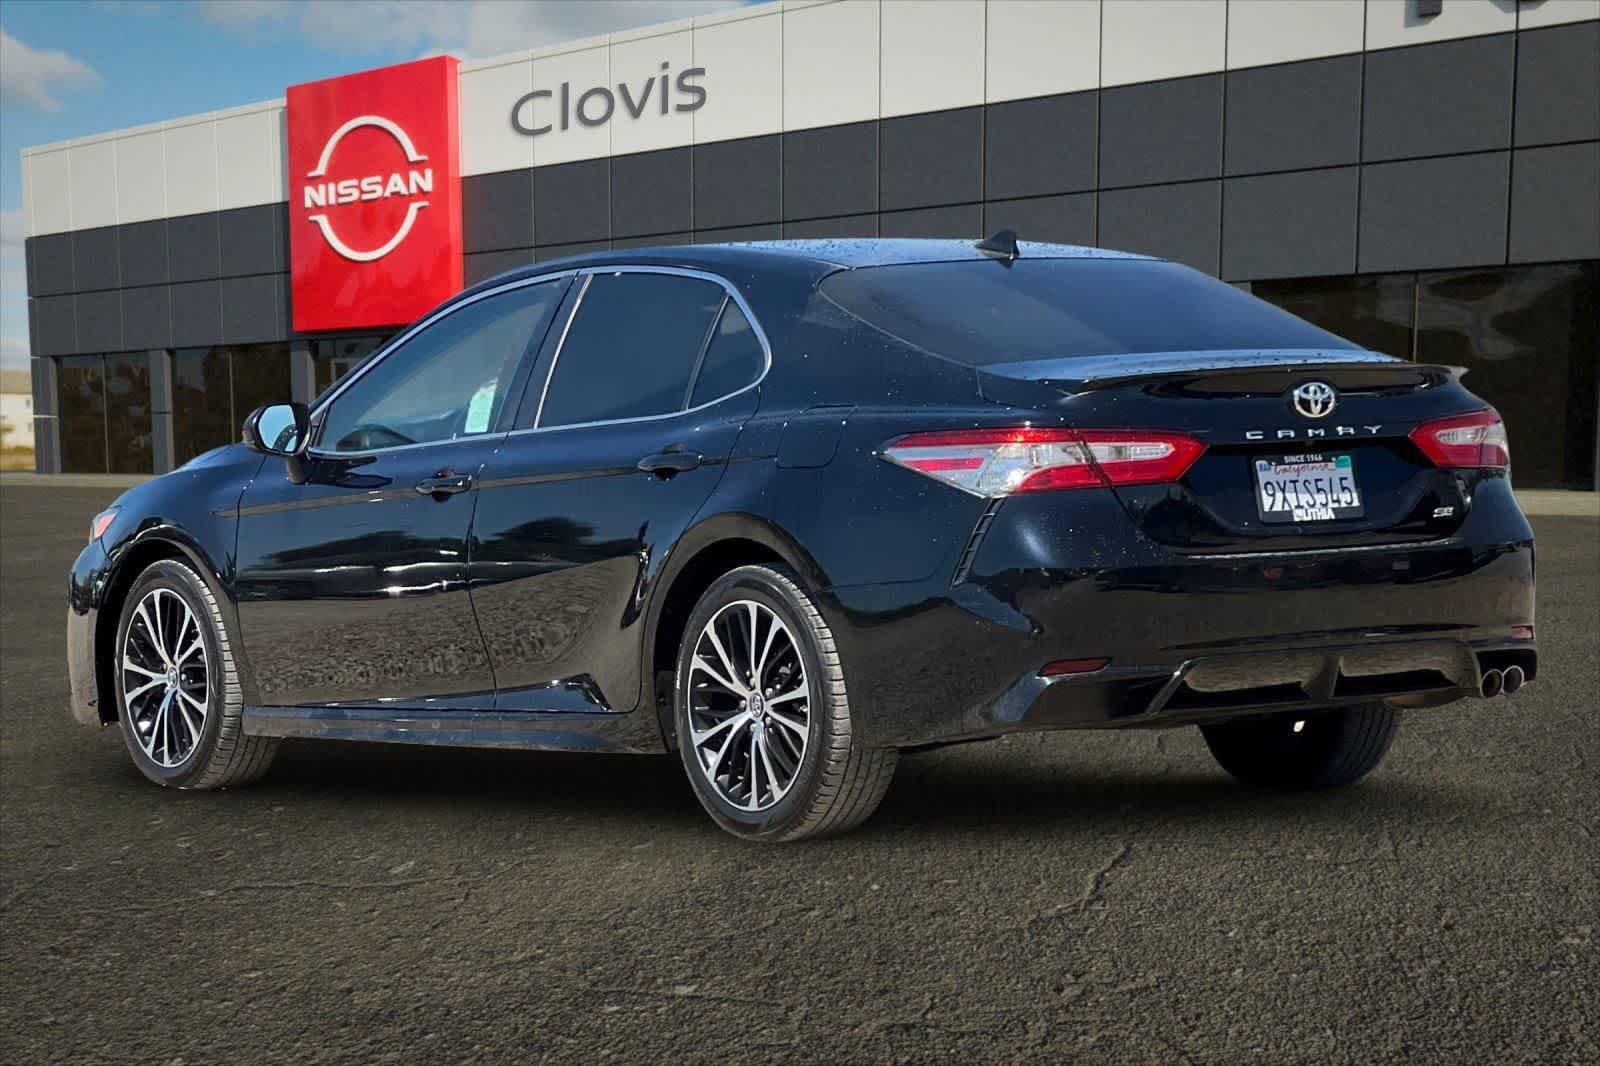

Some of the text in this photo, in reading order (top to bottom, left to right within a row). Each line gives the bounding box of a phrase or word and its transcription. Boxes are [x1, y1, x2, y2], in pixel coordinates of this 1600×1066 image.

[511, 62, 708, 137] Clovis
[303, 168, 434, 209] NISSAN
[1245, 424, 1383, 440] CAMRY
[1283, 455, 1305, 464] SINCE
[1274, 463, 1334, 476] California
[1432, 506, 1454, 518] SE
